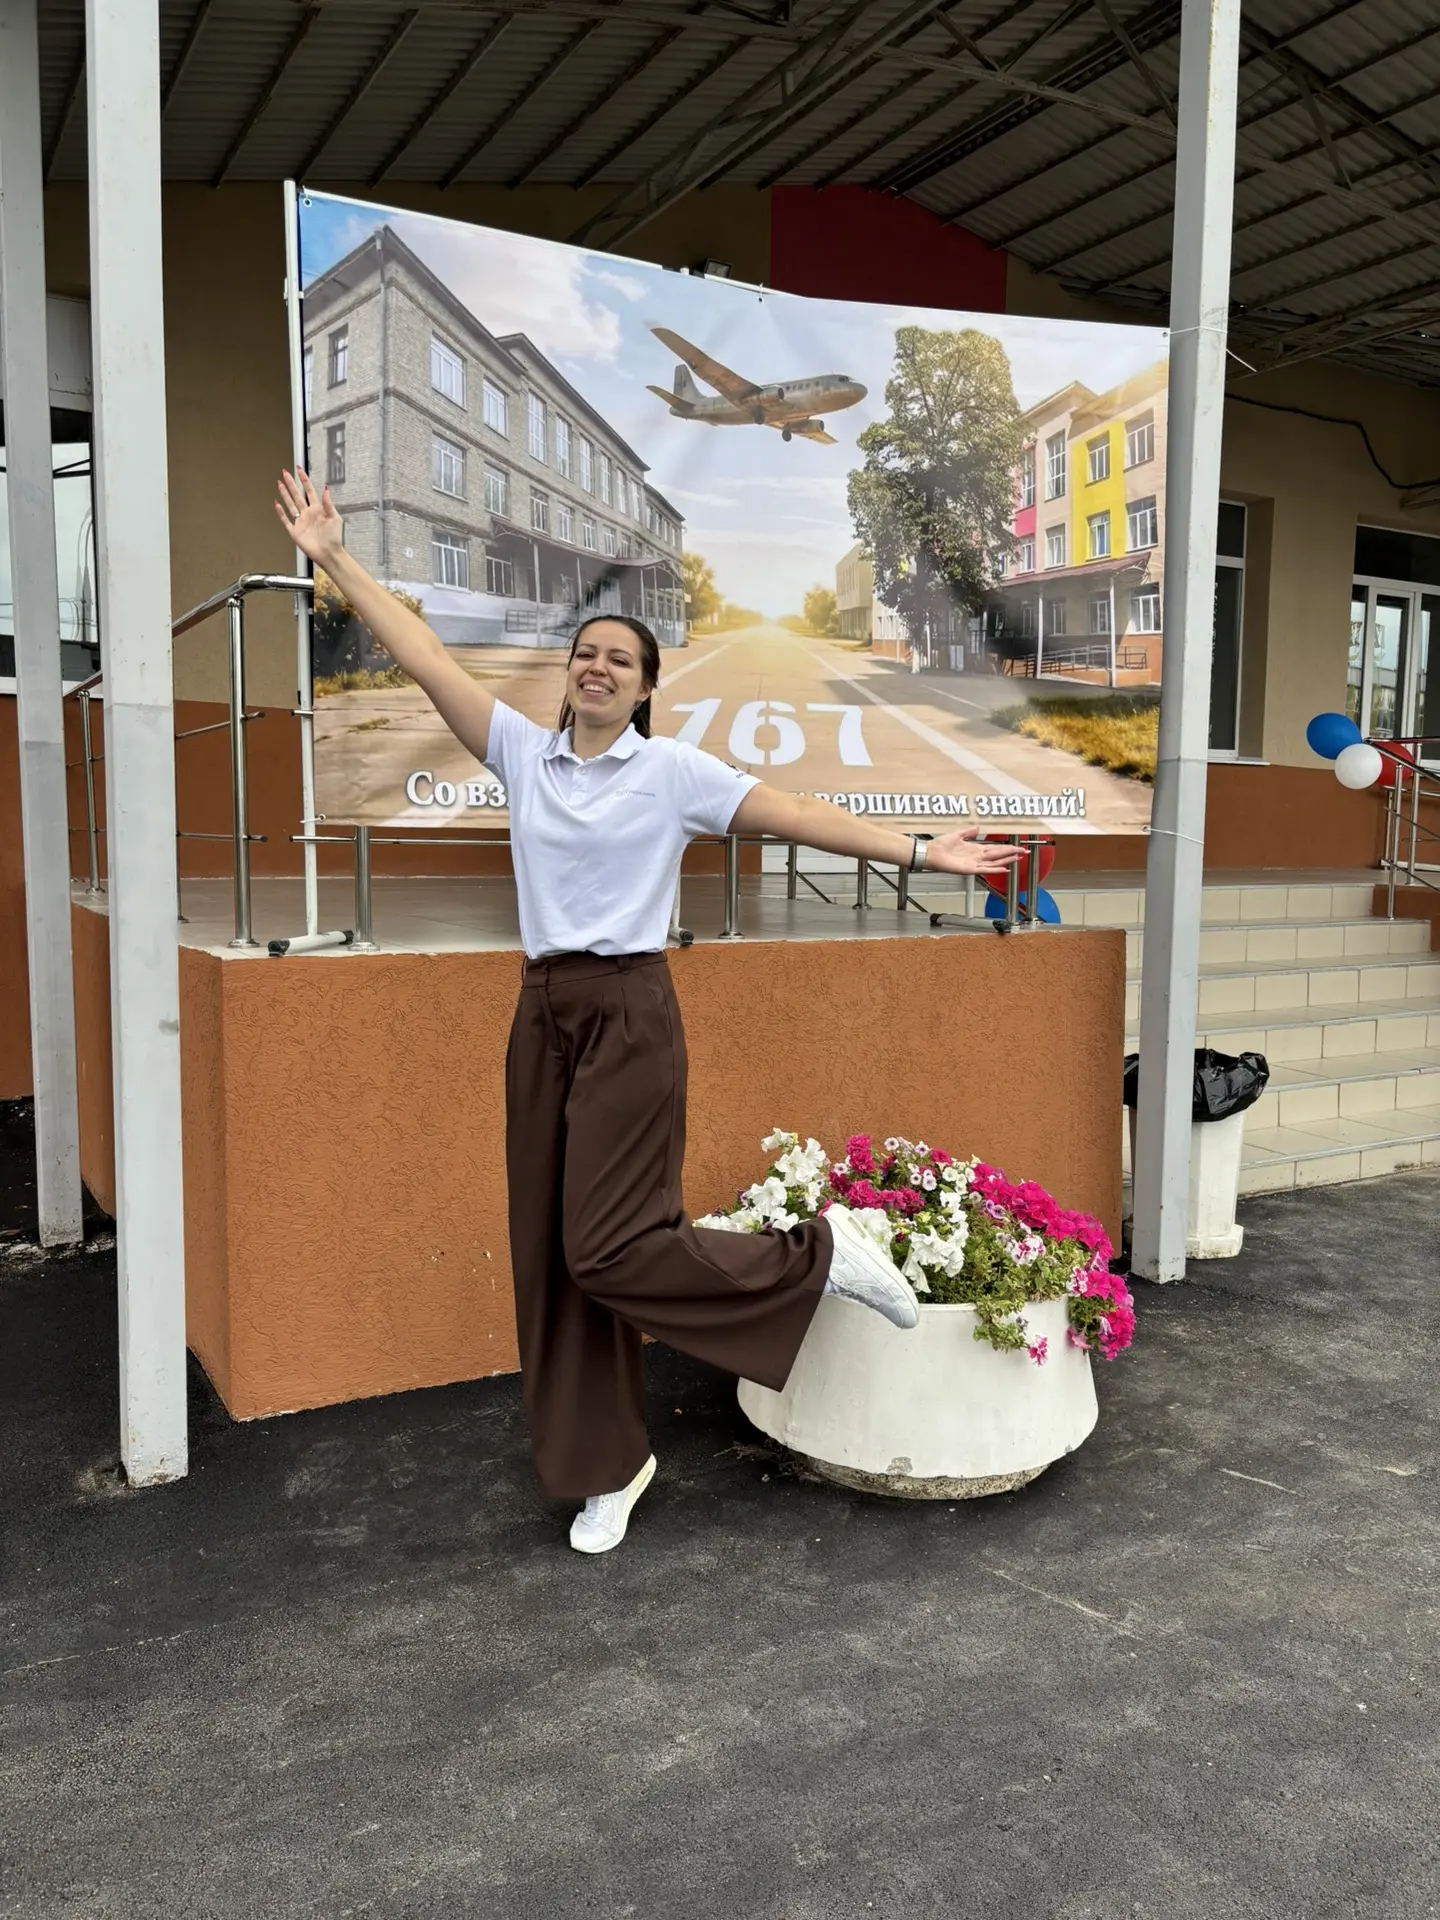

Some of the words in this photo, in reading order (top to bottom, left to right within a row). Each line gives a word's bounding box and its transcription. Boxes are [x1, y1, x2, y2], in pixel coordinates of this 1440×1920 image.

[670, 698, 874, 766] 167
[406, 770, 456, 807] Со
[465, 782, 510, 808] вз
[975, 787, 1086, 817] знаний!
